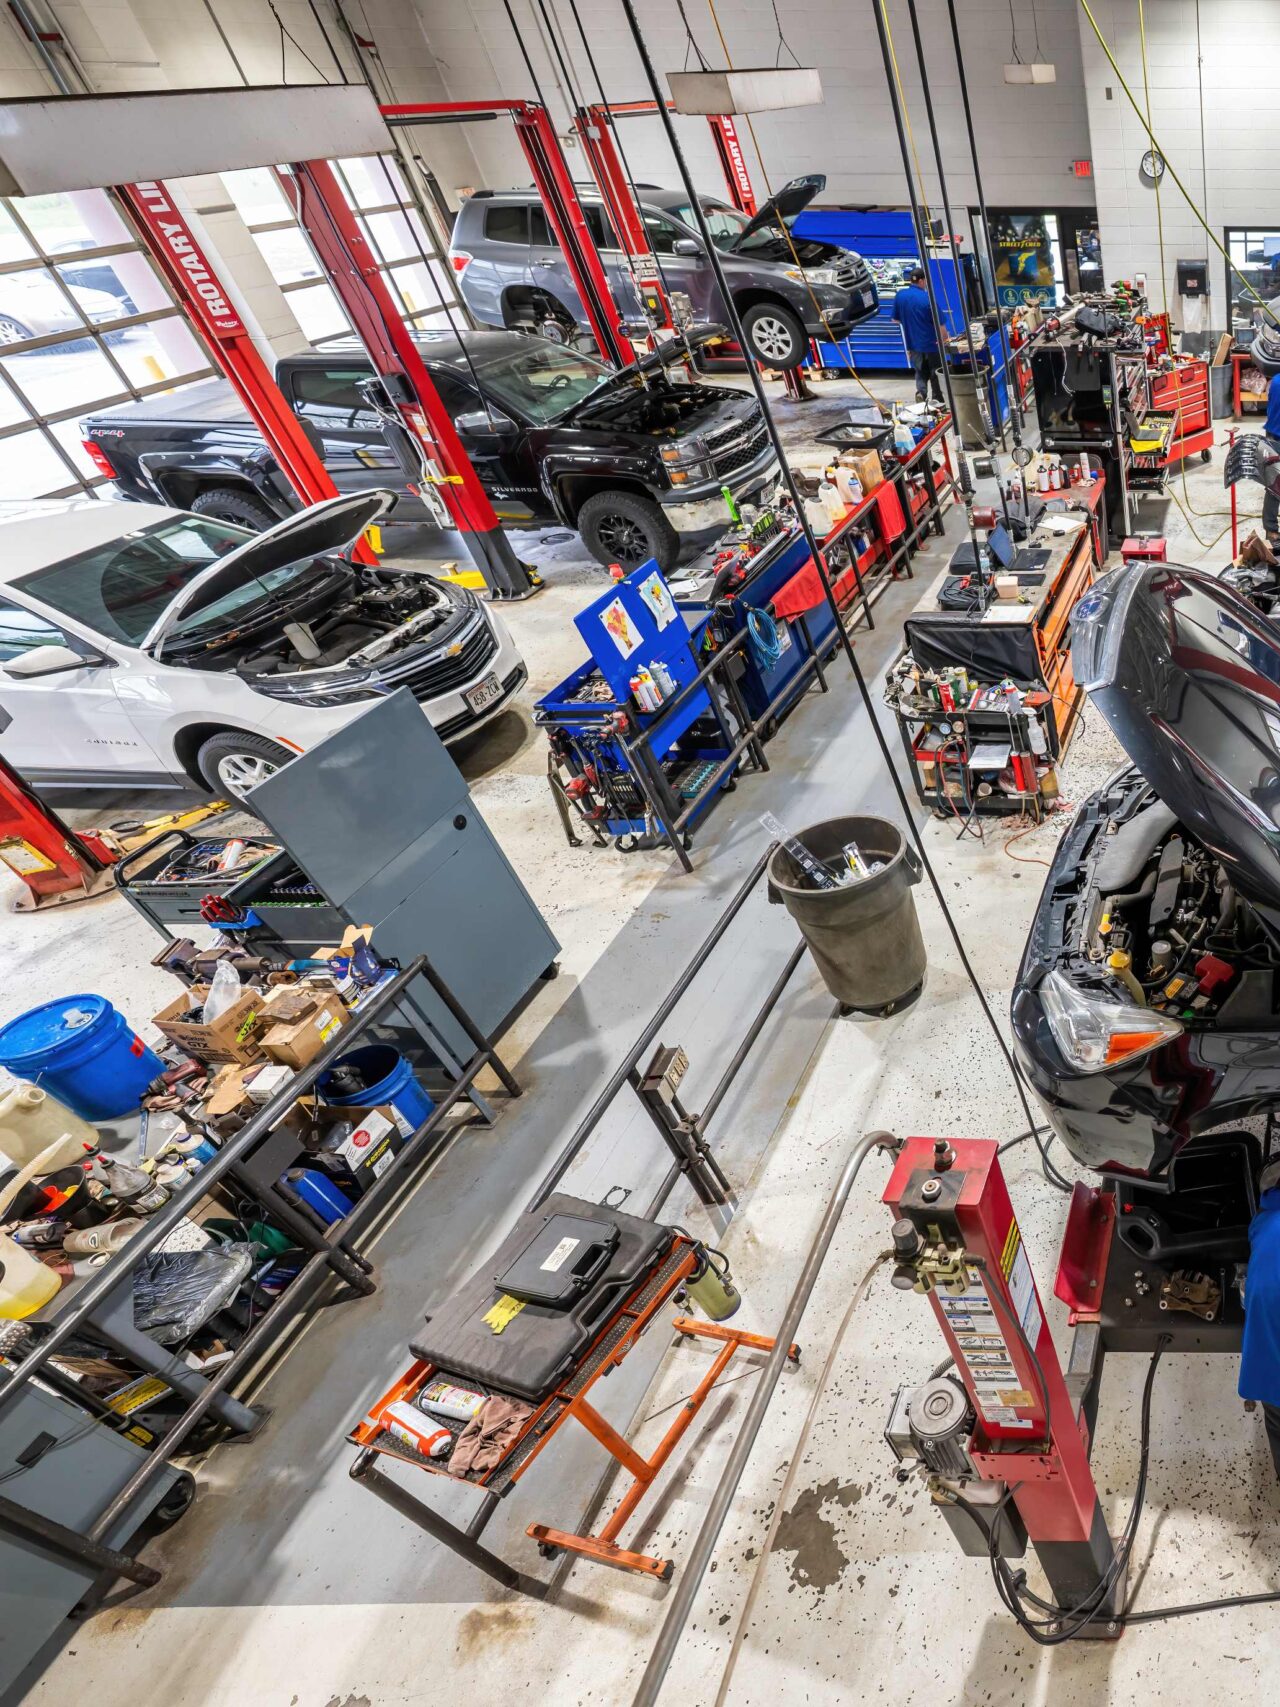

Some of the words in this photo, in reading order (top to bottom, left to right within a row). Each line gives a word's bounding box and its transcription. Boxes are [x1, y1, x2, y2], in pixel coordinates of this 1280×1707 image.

[721, 114, 735, 137] LIF
[728, 139, 751, 191] ROTARY
[156, 218, 231, 317] ROTARY
[187, 1041, 210, 1049] GTX
